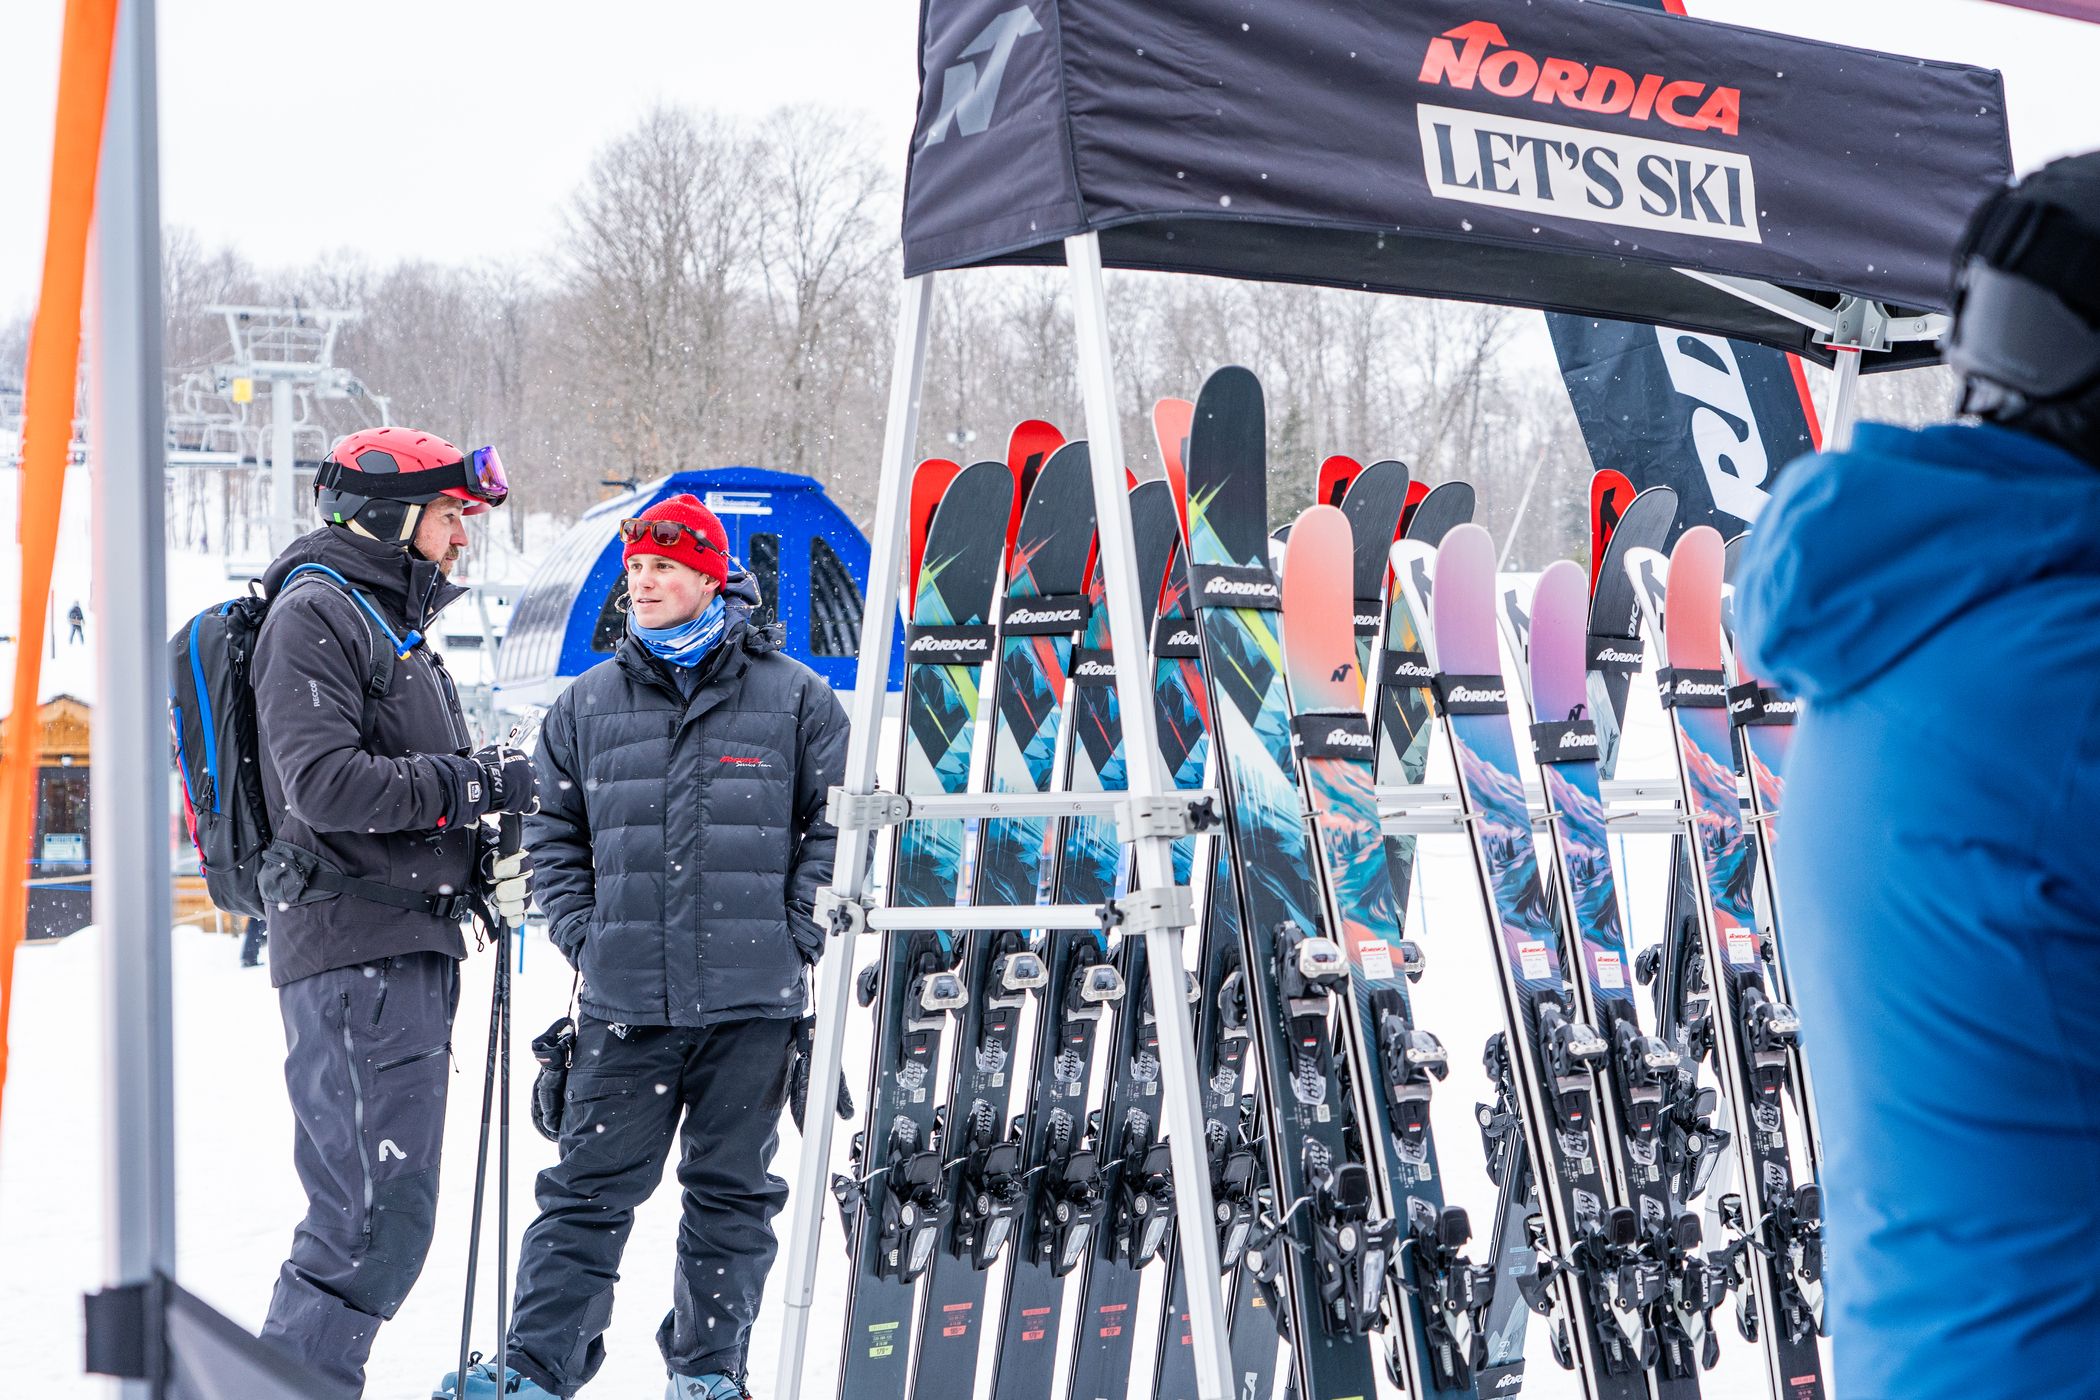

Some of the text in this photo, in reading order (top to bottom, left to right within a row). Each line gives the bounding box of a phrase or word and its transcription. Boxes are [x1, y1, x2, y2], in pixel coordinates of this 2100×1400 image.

[1418, 20, 1741, 136] NORDICA
[1432, 122, 1749, 227] LET'S SKI
